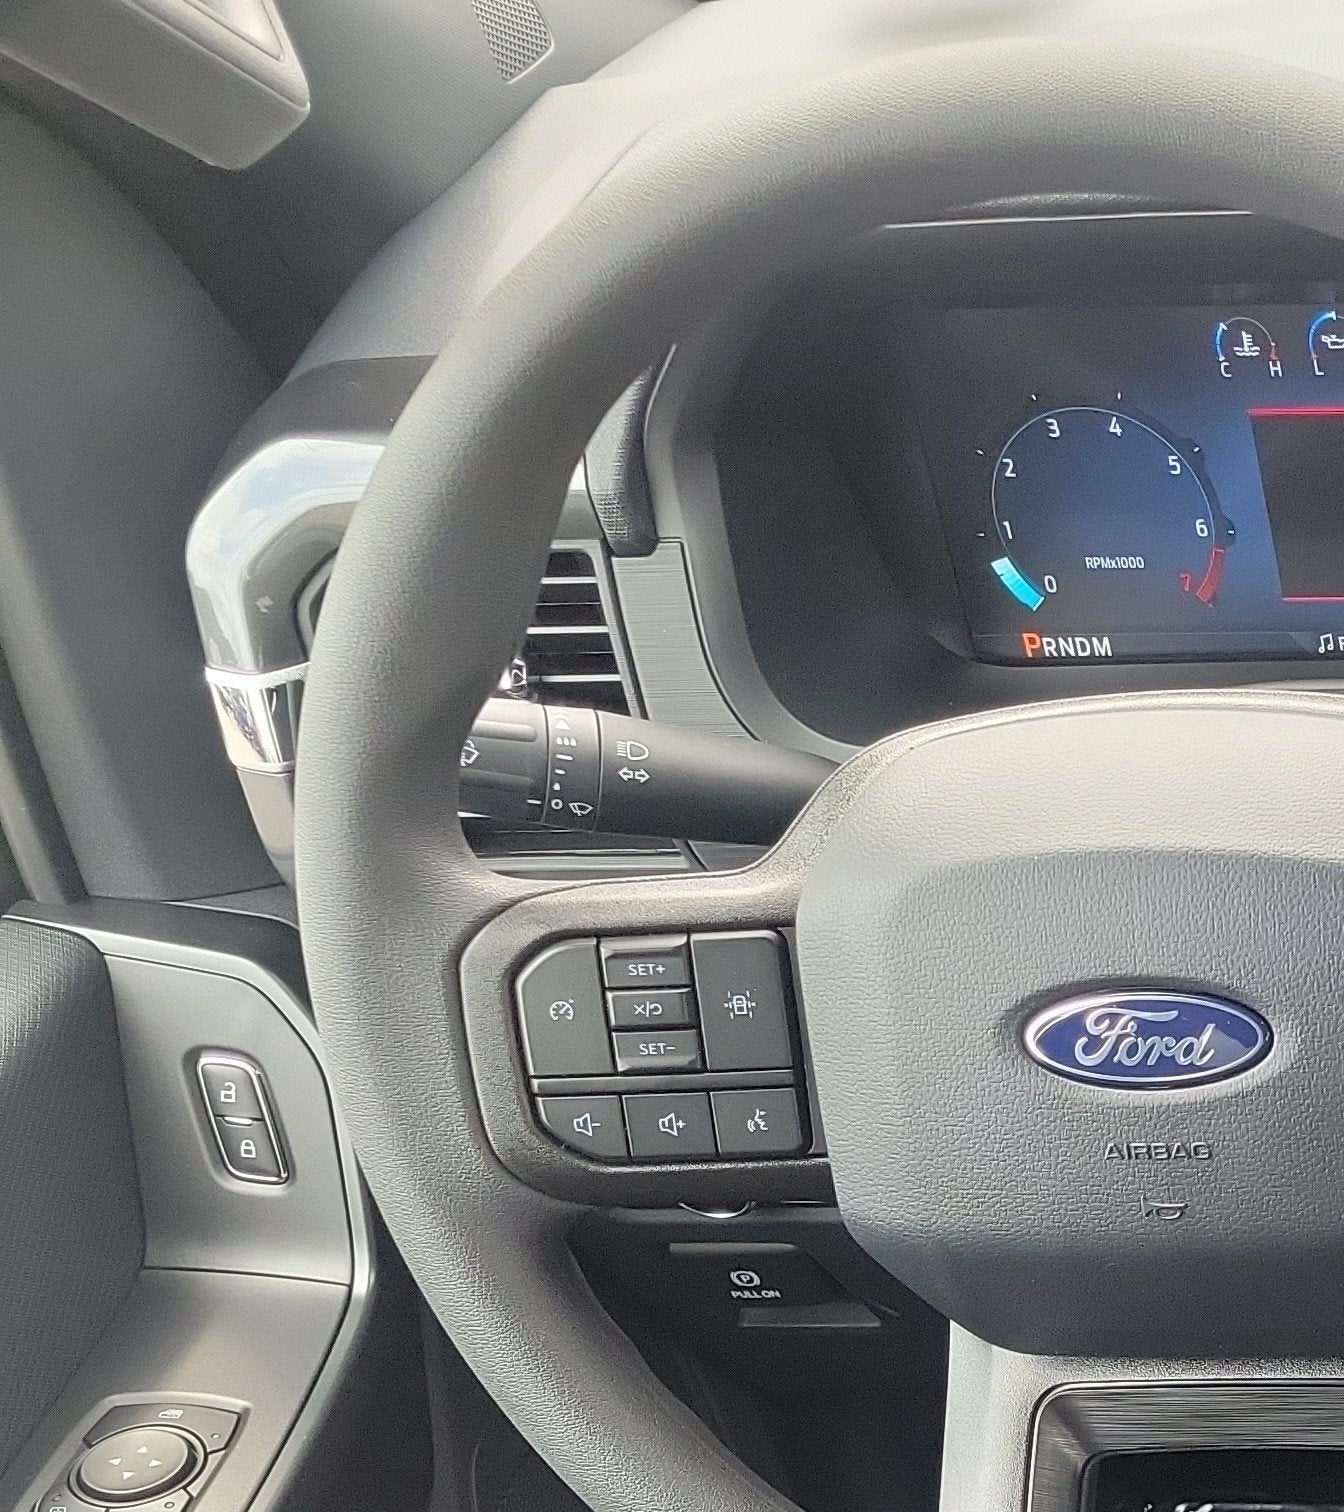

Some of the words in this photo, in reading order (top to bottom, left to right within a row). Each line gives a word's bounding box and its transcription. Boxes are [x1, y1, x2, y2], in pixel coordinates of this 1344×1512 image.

[1219, 361, 1232, 378] C
[1269, 361, 1283, 378] H
[1314, 360, 1324, 377] L
[1045, 418, 1061, 438] 3
[1108, 416, 1123, 437] 4
[1002, 458, 1017, 478] 2
[1167, 455, 1181, 475] 5
[1002, 520, 1014, 540] 1
[1195, 518, 1208, 537] 6
[1085, 556, 1145, 570] RPMx1000
[1043, 574, 1058, 594] 0
[1180, 572, 1192, 592] 7
[627, 962, 667, 977] SET+
[1073, 1006, 1216, 1068] Ford
[1103, 1141, 1214, 1161] AIRBAG
[731, 1289, 761, 1299] PULL
[761, 1289, 782, 1299] ON
